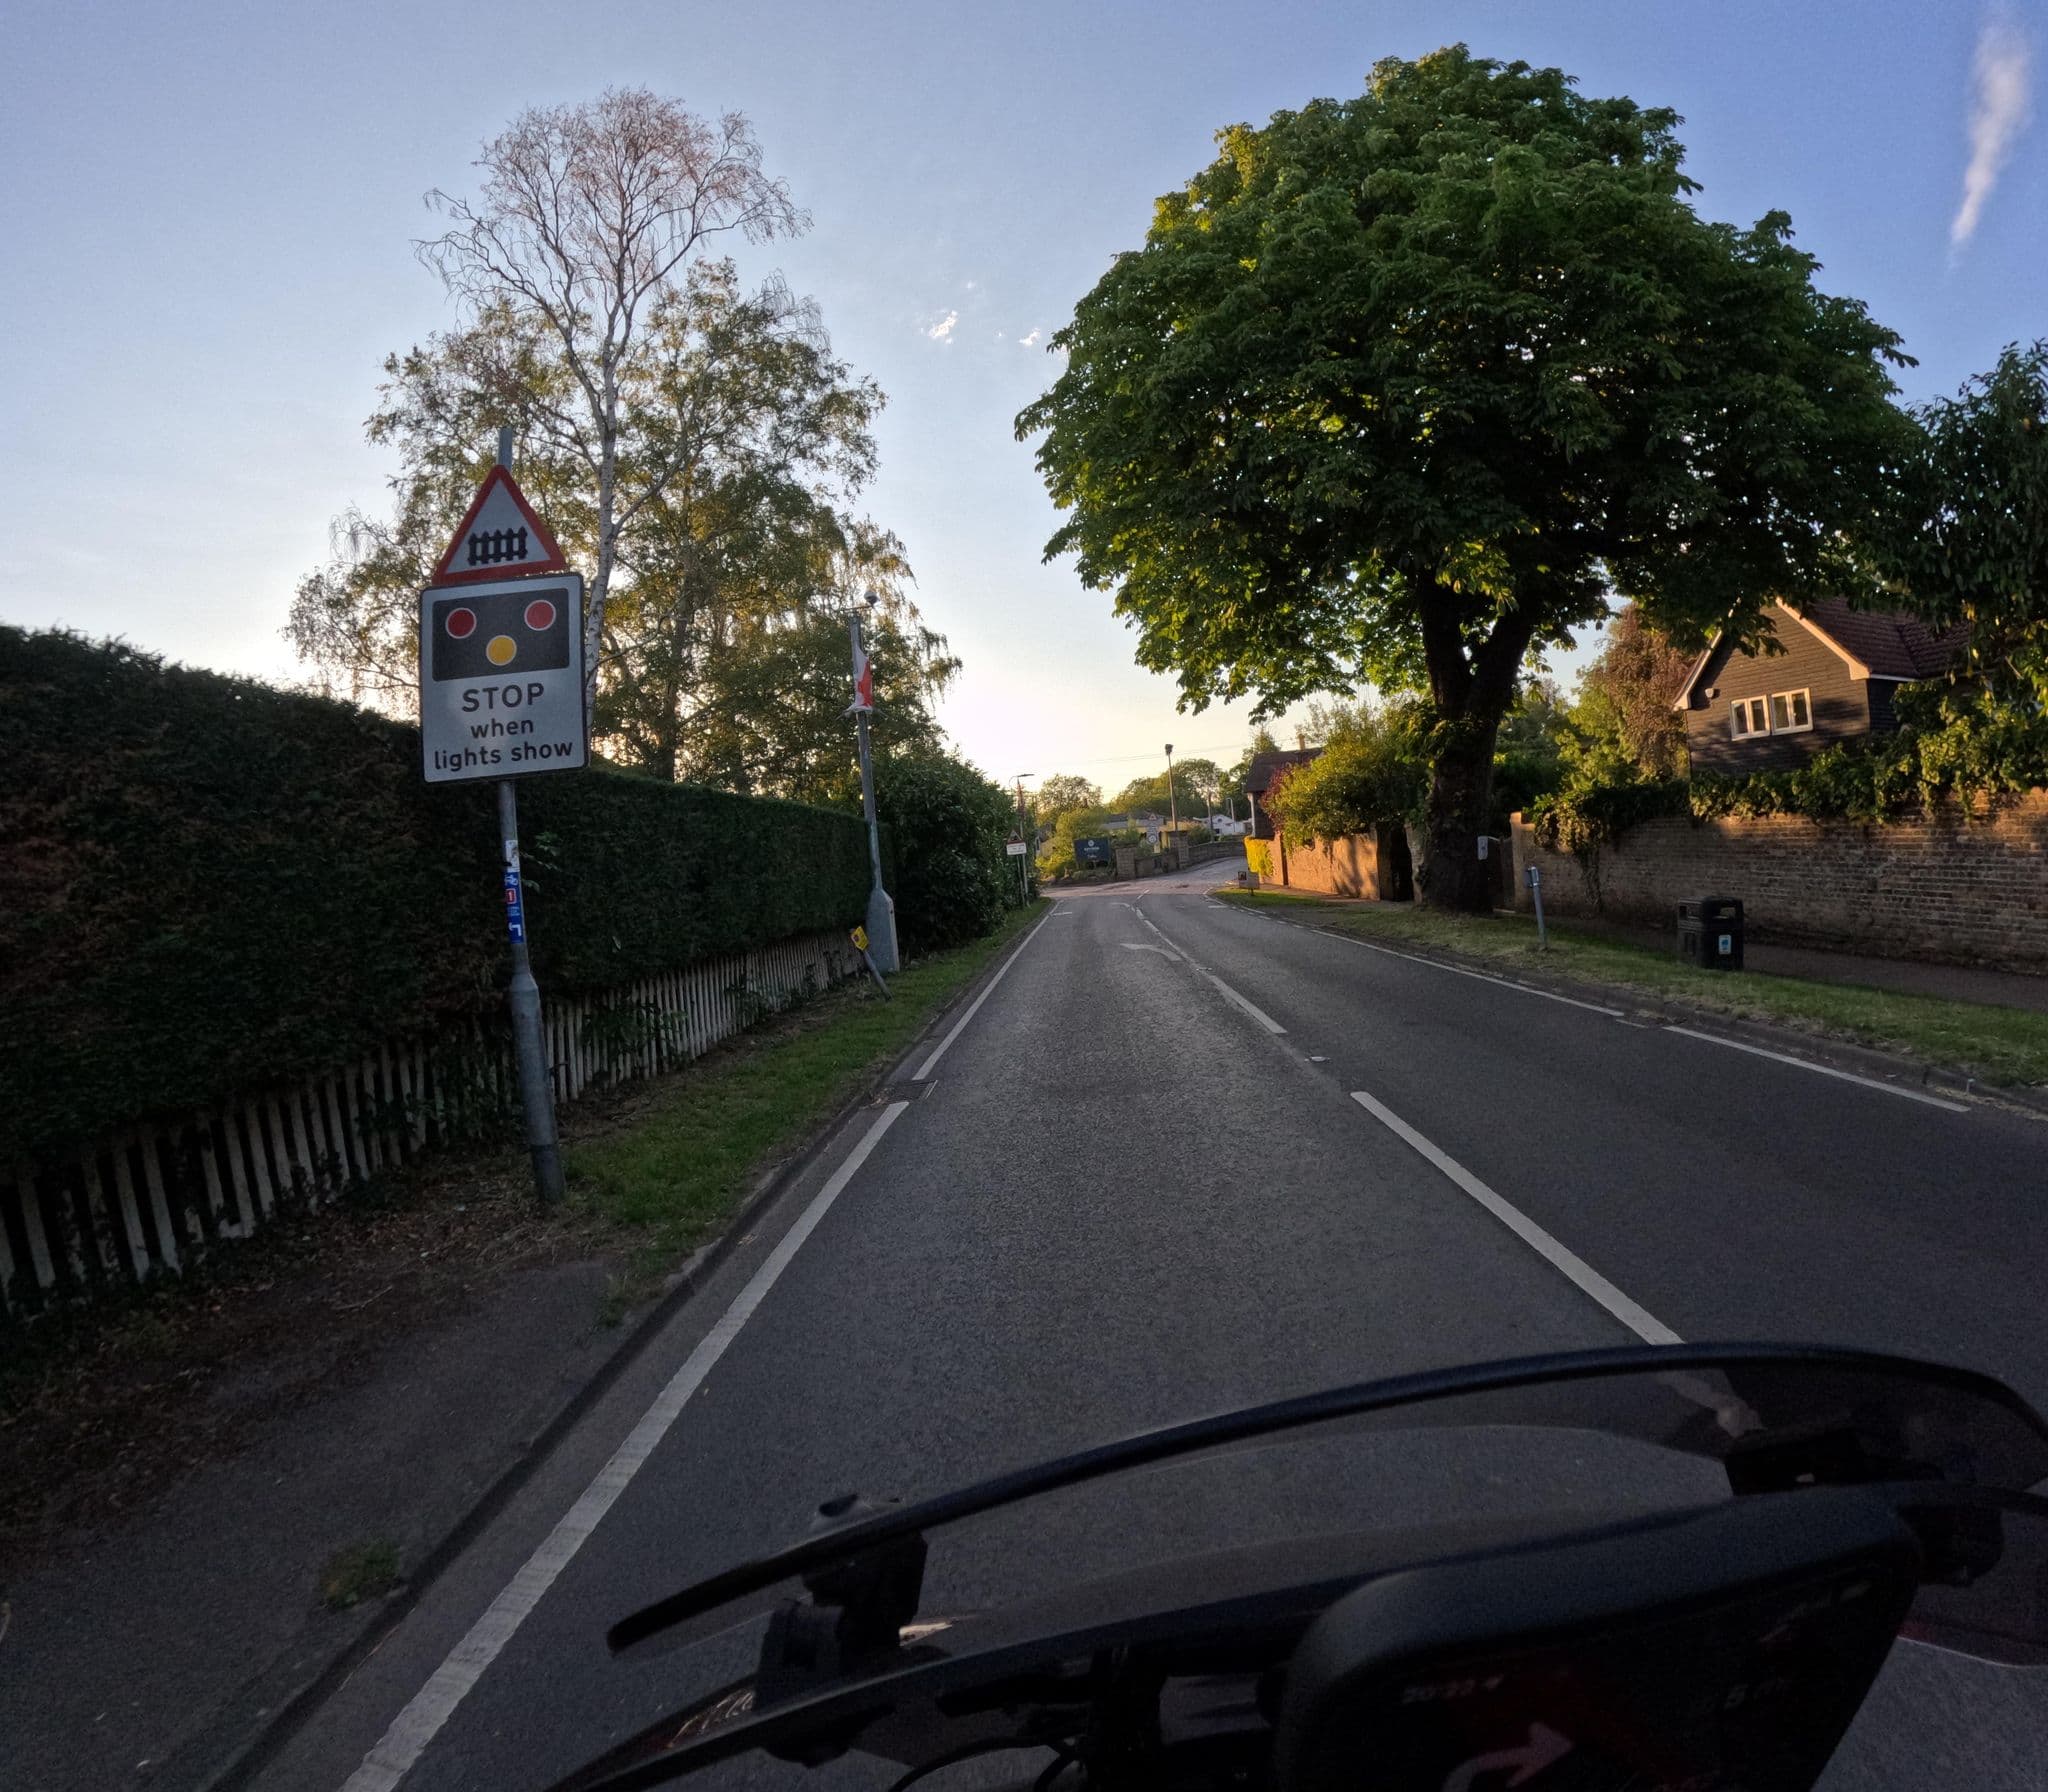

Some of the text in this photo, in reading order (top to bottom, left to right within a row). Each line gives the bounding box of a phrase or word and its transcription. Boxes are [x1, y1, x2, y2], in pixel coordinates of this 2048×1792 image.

[461, 682, 544, 712] STOP
[470, 718, 534, 739] when
[434, 741, 573, 772] lights show
